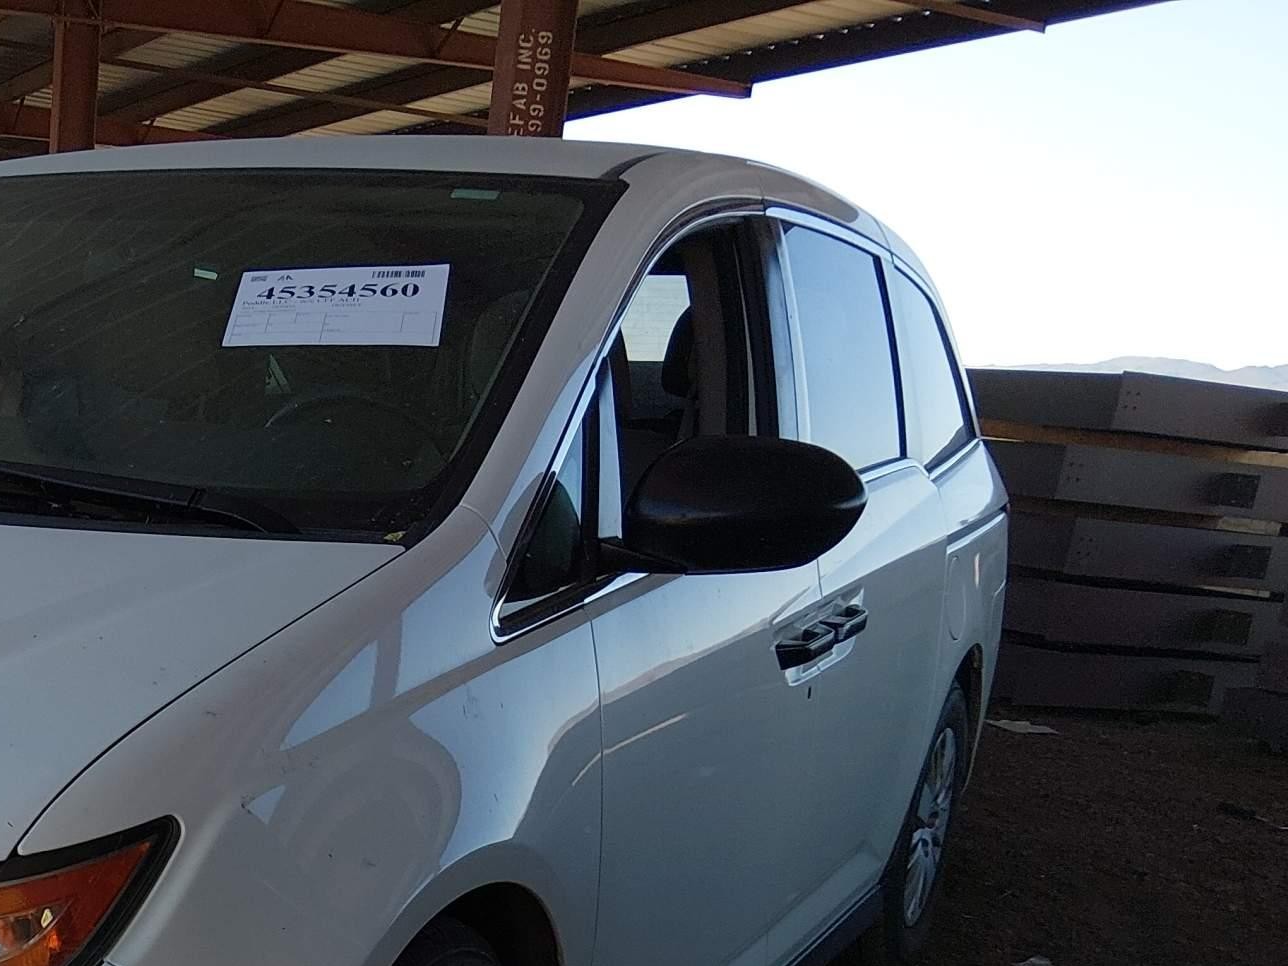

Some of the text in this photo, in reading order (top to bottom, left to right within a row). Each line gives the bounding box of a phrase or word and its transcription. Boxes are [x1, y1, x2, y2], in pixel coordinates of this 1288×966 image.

[516, 28, 535, 70] INC.
[527, 31, 553, 132] 99-0969
[257, 282, 420, 300] 45354560
